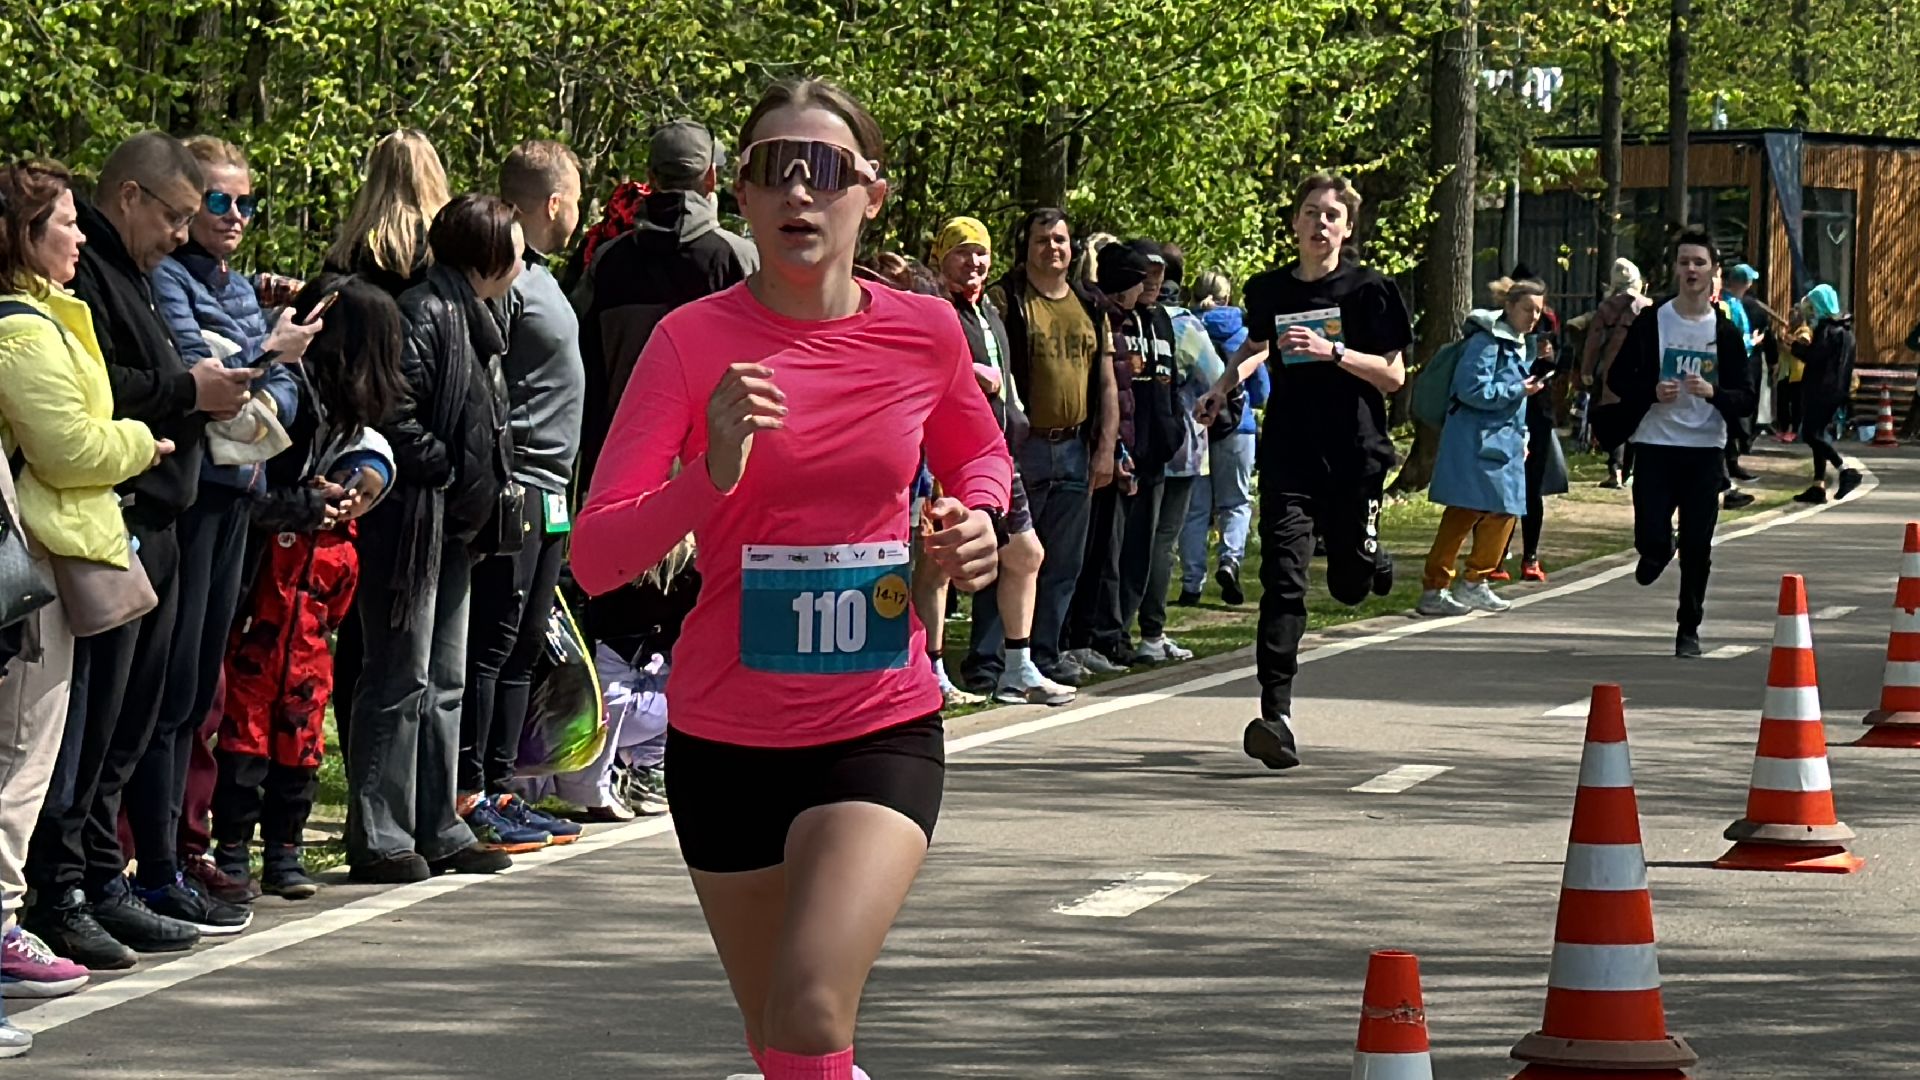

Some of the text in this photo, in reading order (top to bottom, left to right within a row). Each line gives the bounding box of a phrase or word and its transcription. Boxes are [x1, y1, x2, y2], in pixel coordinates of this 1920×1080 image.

[1676, 355, 1702, 377] 140
[876, 586, 905, 604] 14-17
[792, 589, 867, 653] 110
